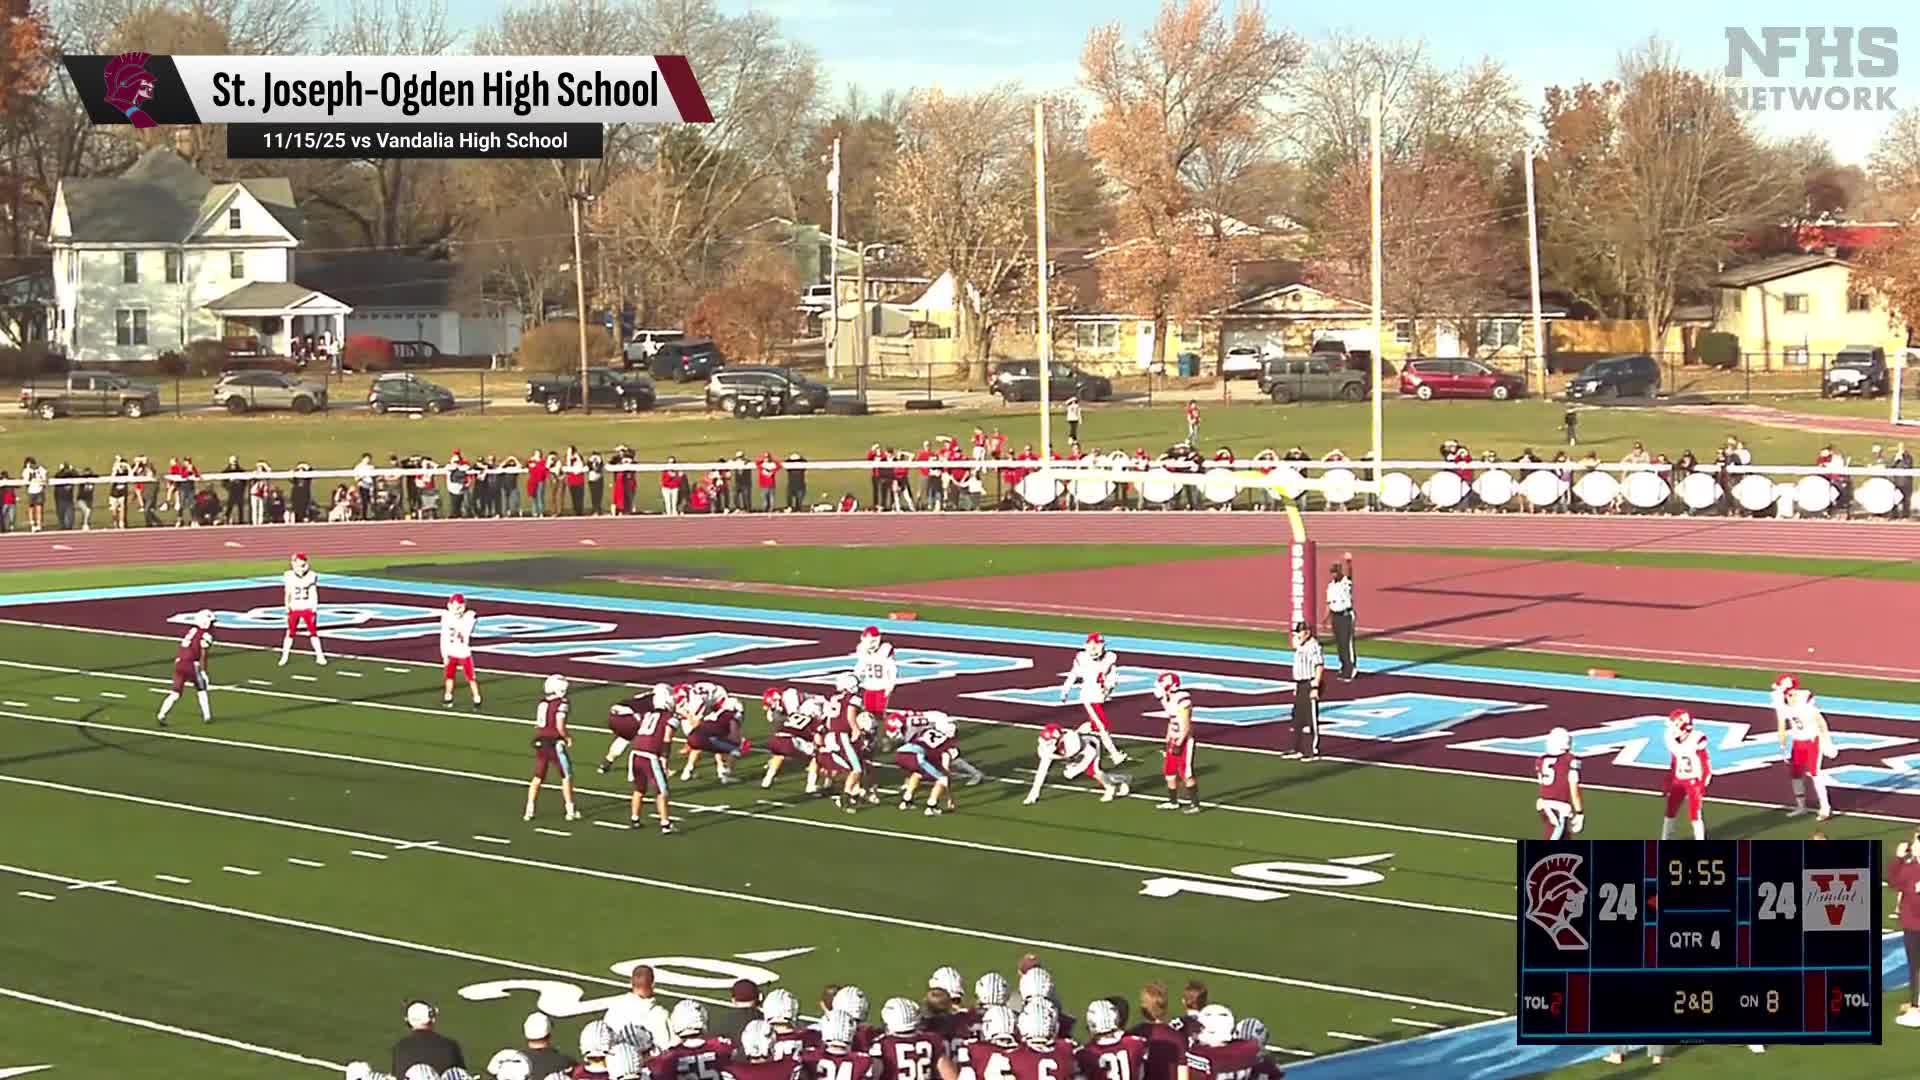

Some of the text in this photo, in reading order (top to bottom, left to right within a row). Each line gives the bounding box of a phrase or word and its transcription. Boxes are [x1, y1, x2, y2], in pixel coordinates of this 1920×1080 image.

[1292, 543, 1305, 631] SPARTA
[1138, 861, 1383, 902] 10
[457, 956, 781, 1018] 20
[895, 1041, 932, 1080] 52
[1099, 1050, 1132, 1080] 31
